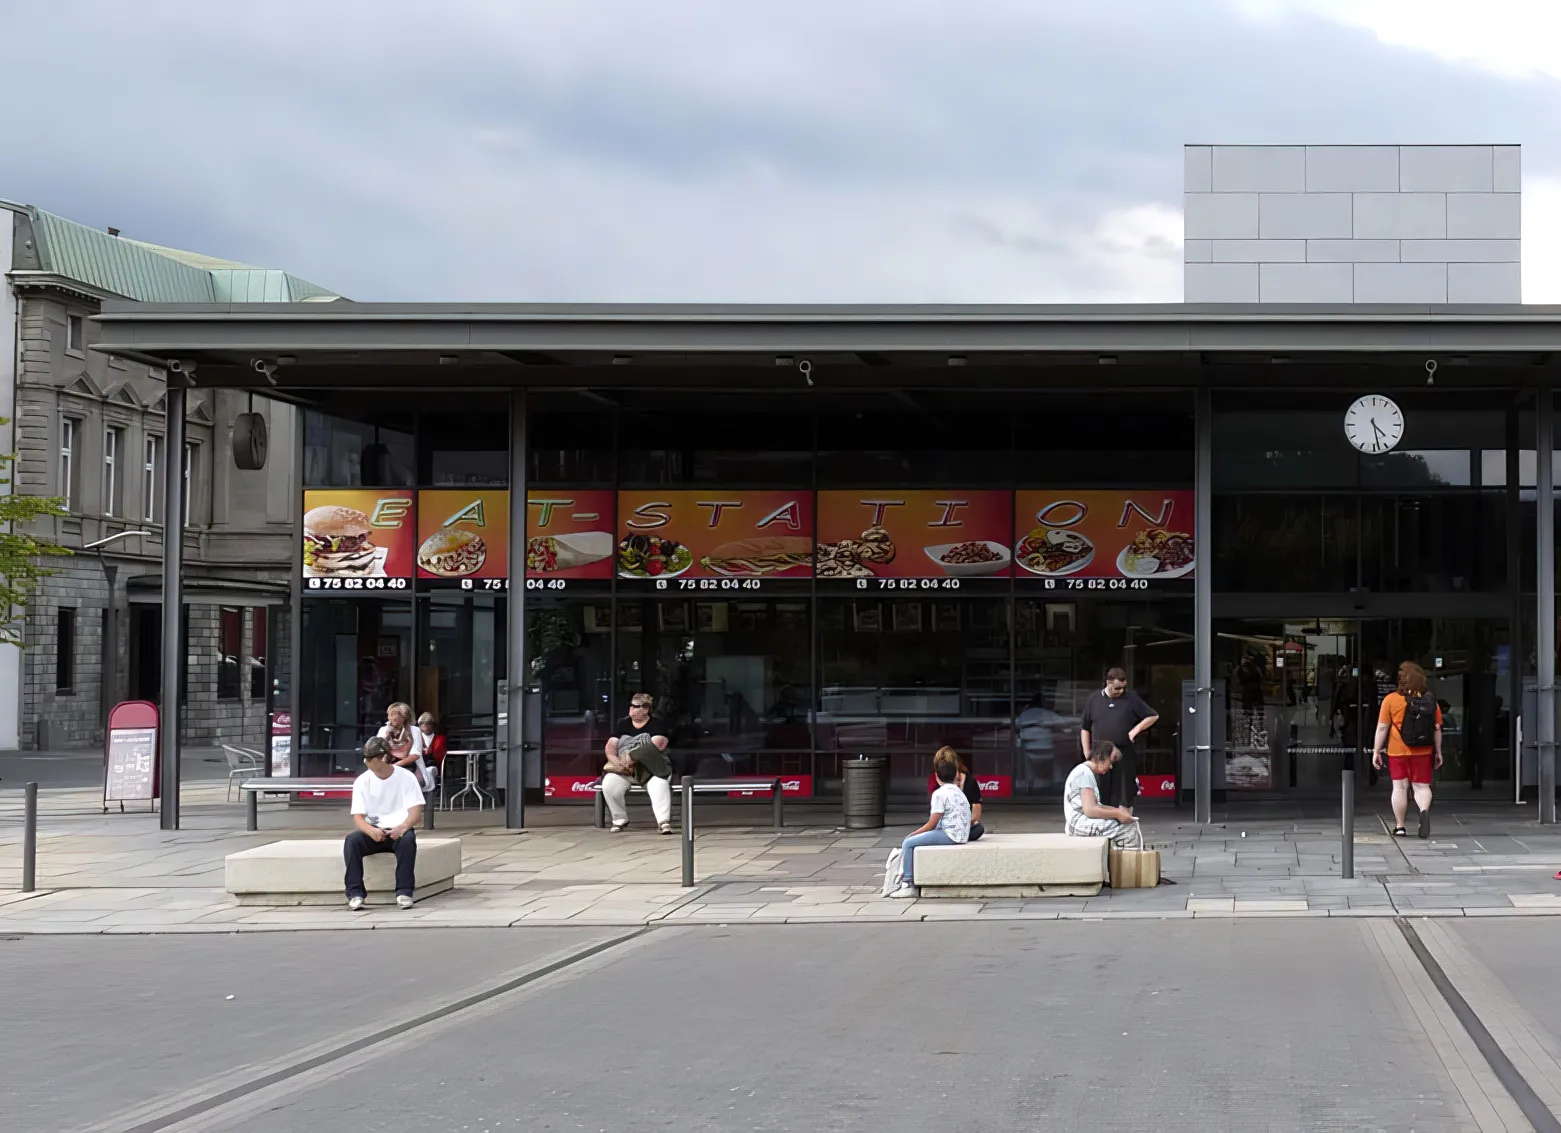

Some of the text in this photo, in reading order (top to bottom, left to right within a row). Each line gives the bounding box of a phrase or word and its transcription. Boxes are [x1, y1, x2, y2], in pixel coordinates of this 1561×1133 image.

[323, 578, 406, 589] 75 82 04 40
[483, 579, 502, 589] 75
[526, 579, 544, 589] 04
[547, 579, 566, 589] 40
[678, 579, 761, 589] 75 82 04 40
[878, 579, 960, 589] 75 82 04 40
[1066, 579, 1148, 589] 75 82 04 40
